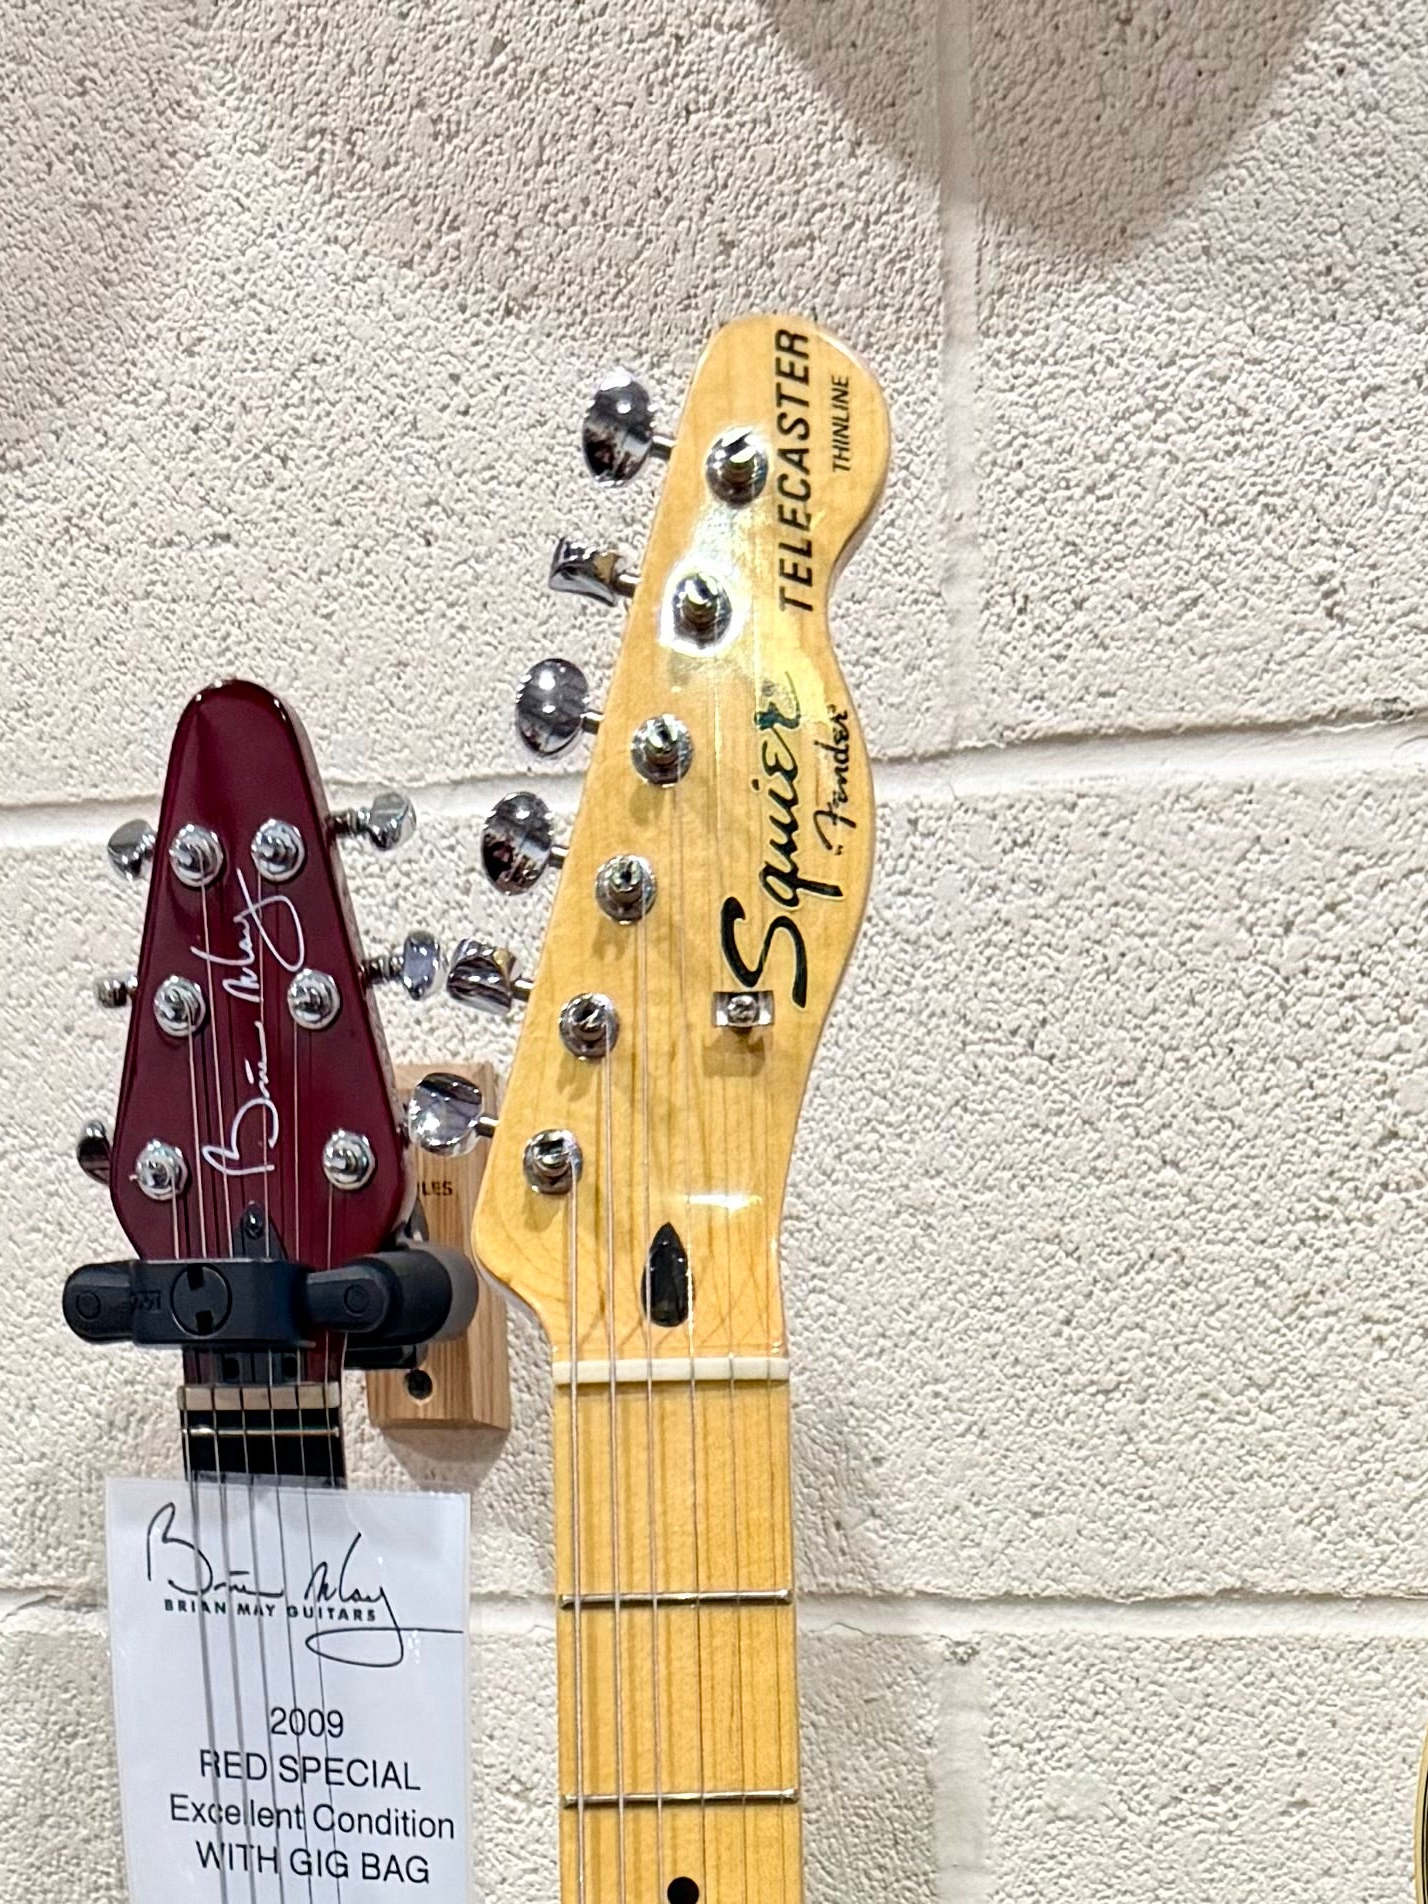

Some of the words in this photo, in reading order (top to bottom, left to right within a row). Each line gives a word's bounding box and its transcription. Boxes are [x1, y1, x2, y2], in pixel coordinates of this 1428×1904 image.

[830, 375, 851, 473] THINLINE
[774, 328, 813, 612] TELECASTER
[812, 703, 857, 850] Fender
[721, 671, 844, 1009] Squier
[164, 1599, 227, 1615] BRIAN
[237, 1603, 276, 1618] MAY
[286, 1604, 377, 1622] GUITARS
[271, 1707, 344, 1739] 2009
[199, 1748, 268, 1781] RED
[278, 1754, 422, 1792] SPECIAL
[313, 1803, 455, 1840] Condition
[195, 1840, 279, 1875] WITH
[289, 1847, 349, 1879] GIG
[361, 1852, 430, 1884] BAG
